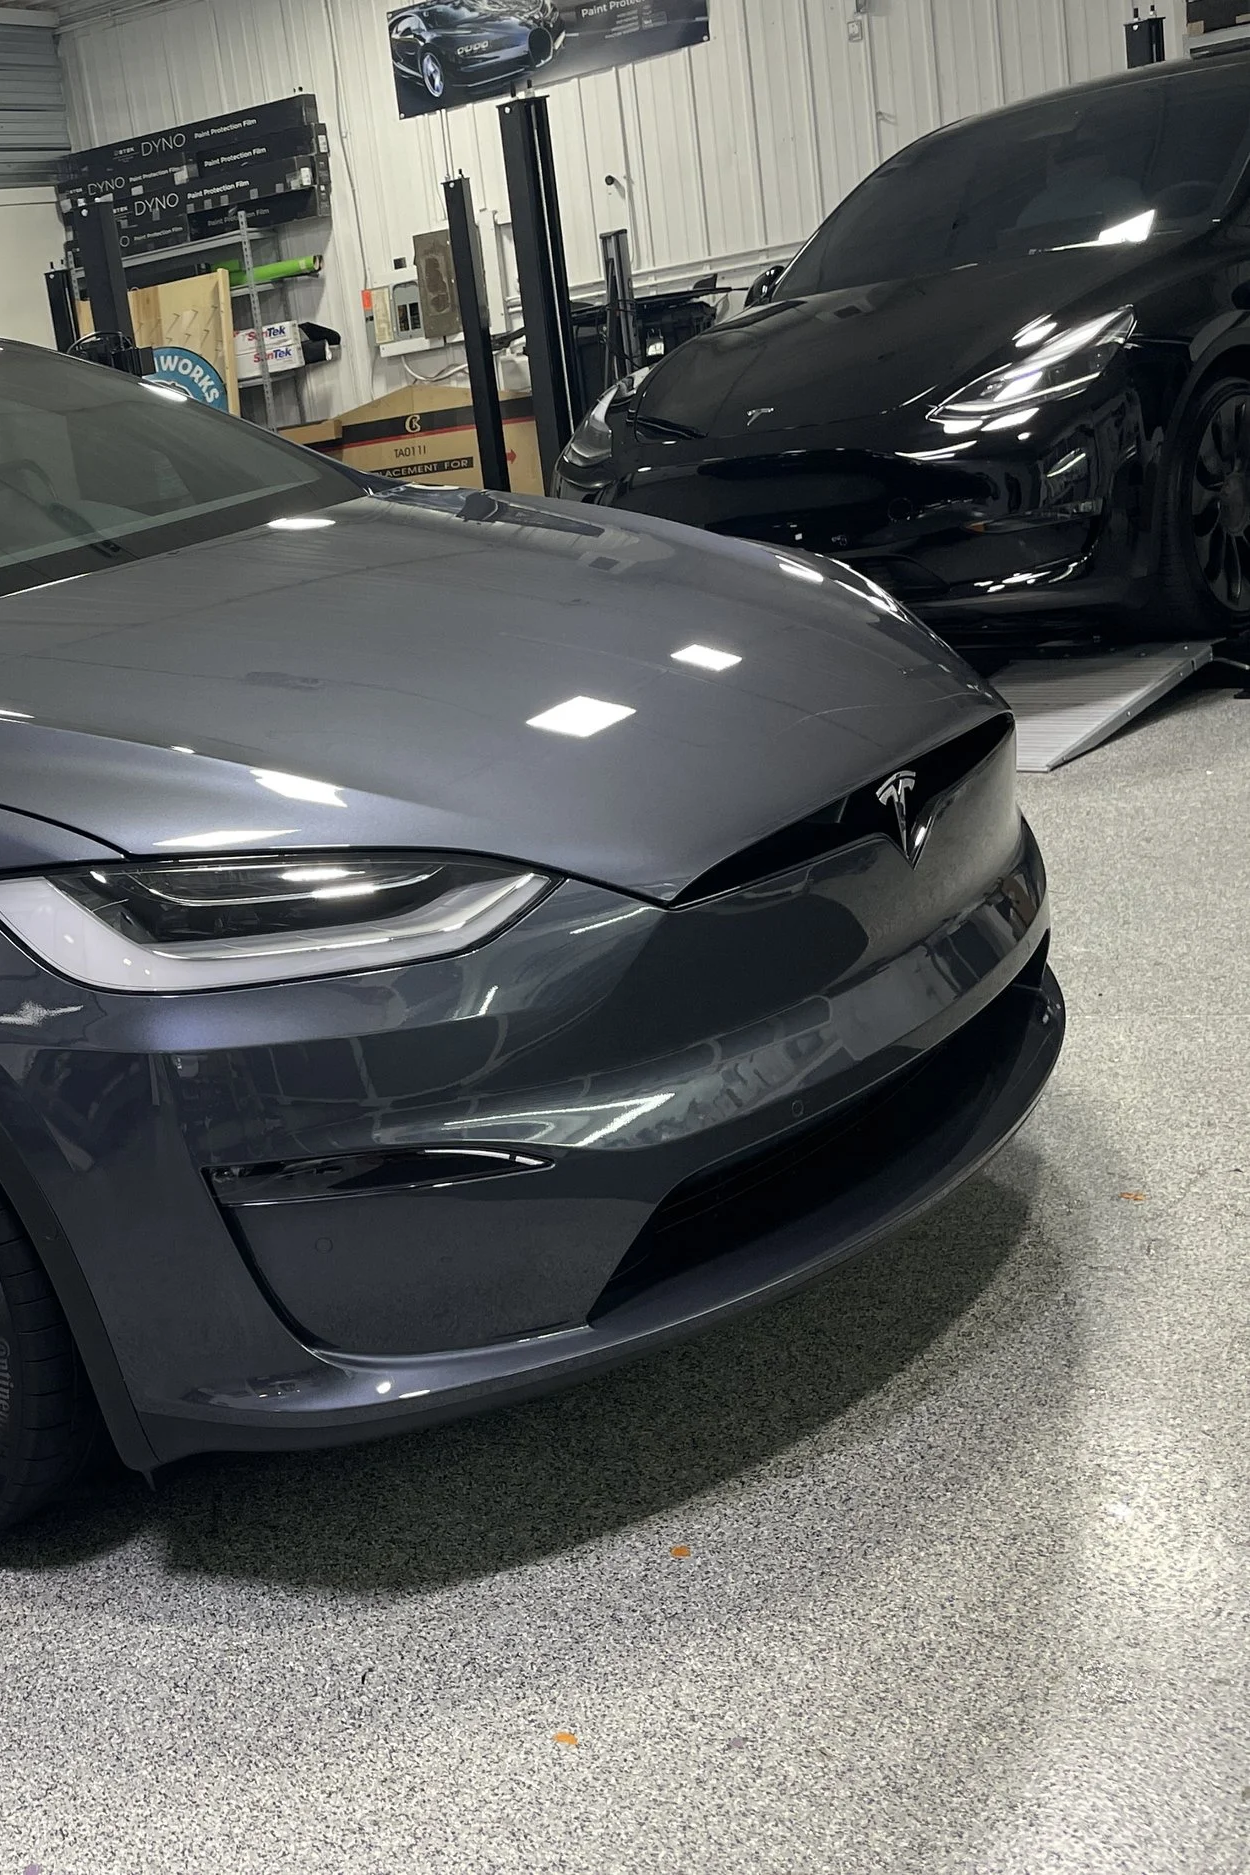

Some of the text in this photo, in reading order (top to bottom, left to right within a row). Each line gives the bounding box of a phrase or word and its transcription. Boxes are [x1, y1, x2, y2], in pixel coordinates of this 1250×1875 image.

[581, 4, 608, 18] Paint
[141, 133, 186, 157] DYNO
[194, 130, 210, 139] Paint
[210, 122, 243, 136] Protection
[242, 118, 257, 127] Film
[204, 147, 267, 168] Paint Protection Film
[87, 176, 126, 196] DYNO
[134, 192, 179, 216] DYNO
[187, 190, 203, 200] Paint
[203, 183, 236, 196] Protection
[235, 180, 250, 188] Film
[207, 218, 224, 227] Paint
[255, 208, 270, 217] Film
[247, 325, 286, 342] SnTek
[253, 347, 292, 363] SnTek
[375, 459, 468, 478] LACEMENT FOR
